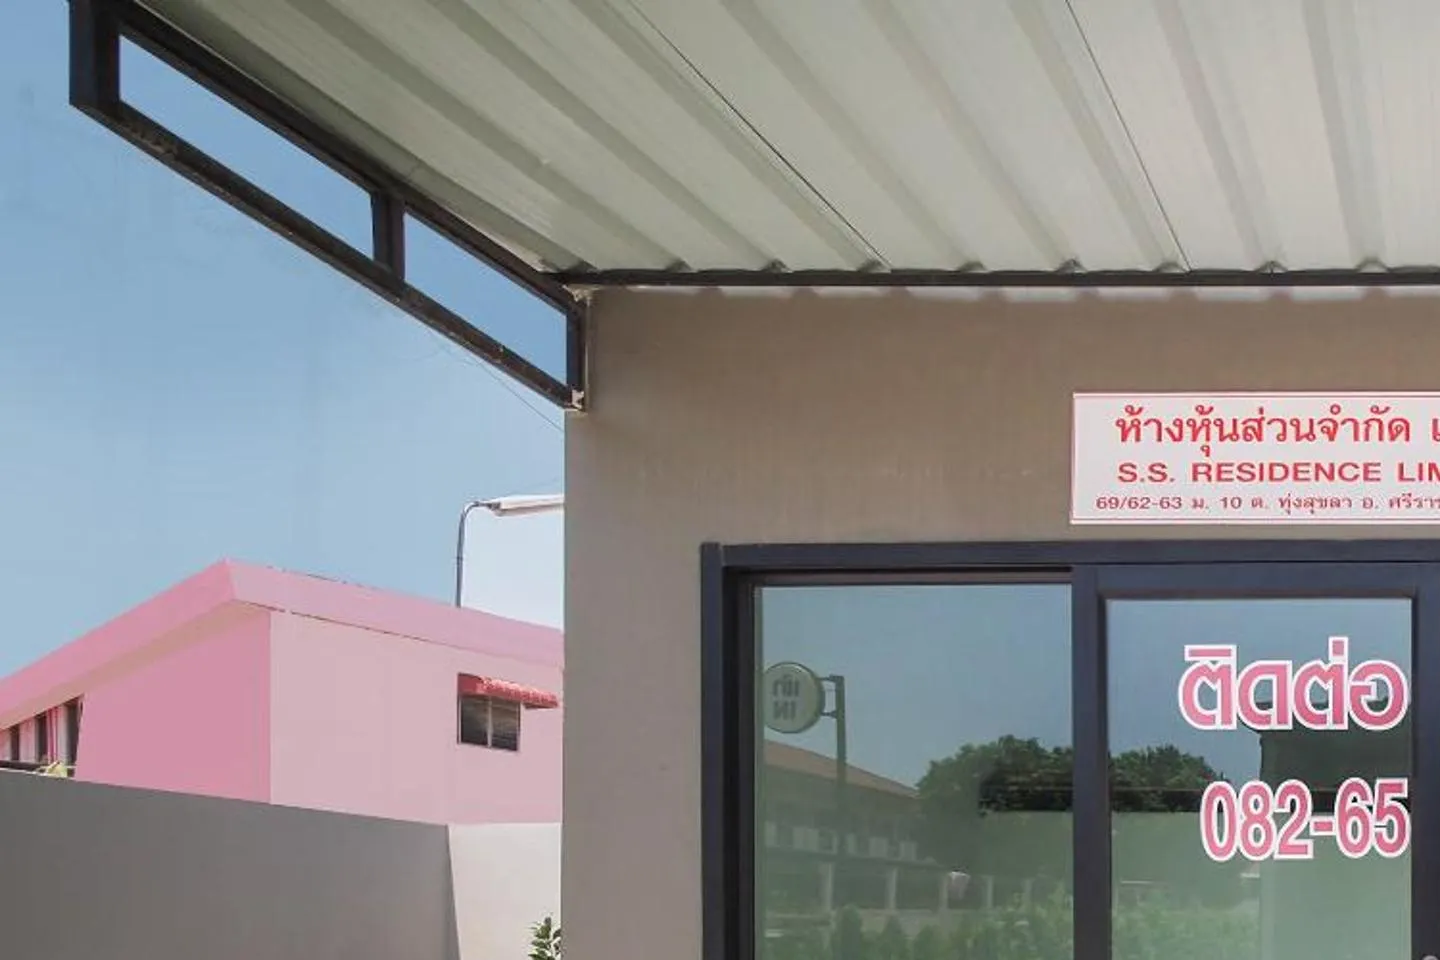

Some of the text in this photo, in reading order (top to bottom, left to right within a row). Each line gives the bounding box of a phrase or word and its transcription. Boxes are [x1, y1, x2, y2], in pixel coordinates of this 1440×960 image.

[1114, 402, 1411, 459] ห้างหุ้นส่วนจำกัด
[1116, 461, 1176, 484] S.S.
[1191, 461, 1382, 483] RESIDENCE
[1095, 496, 1183, 510] 69/62-63
[1191, 497, 1210, 510] ม.
[1219, 496, 1243, 510] 10
[1178, 636, 1409, 730] ติดต่อ
[1200, 777, 1411, 862] 082-65
